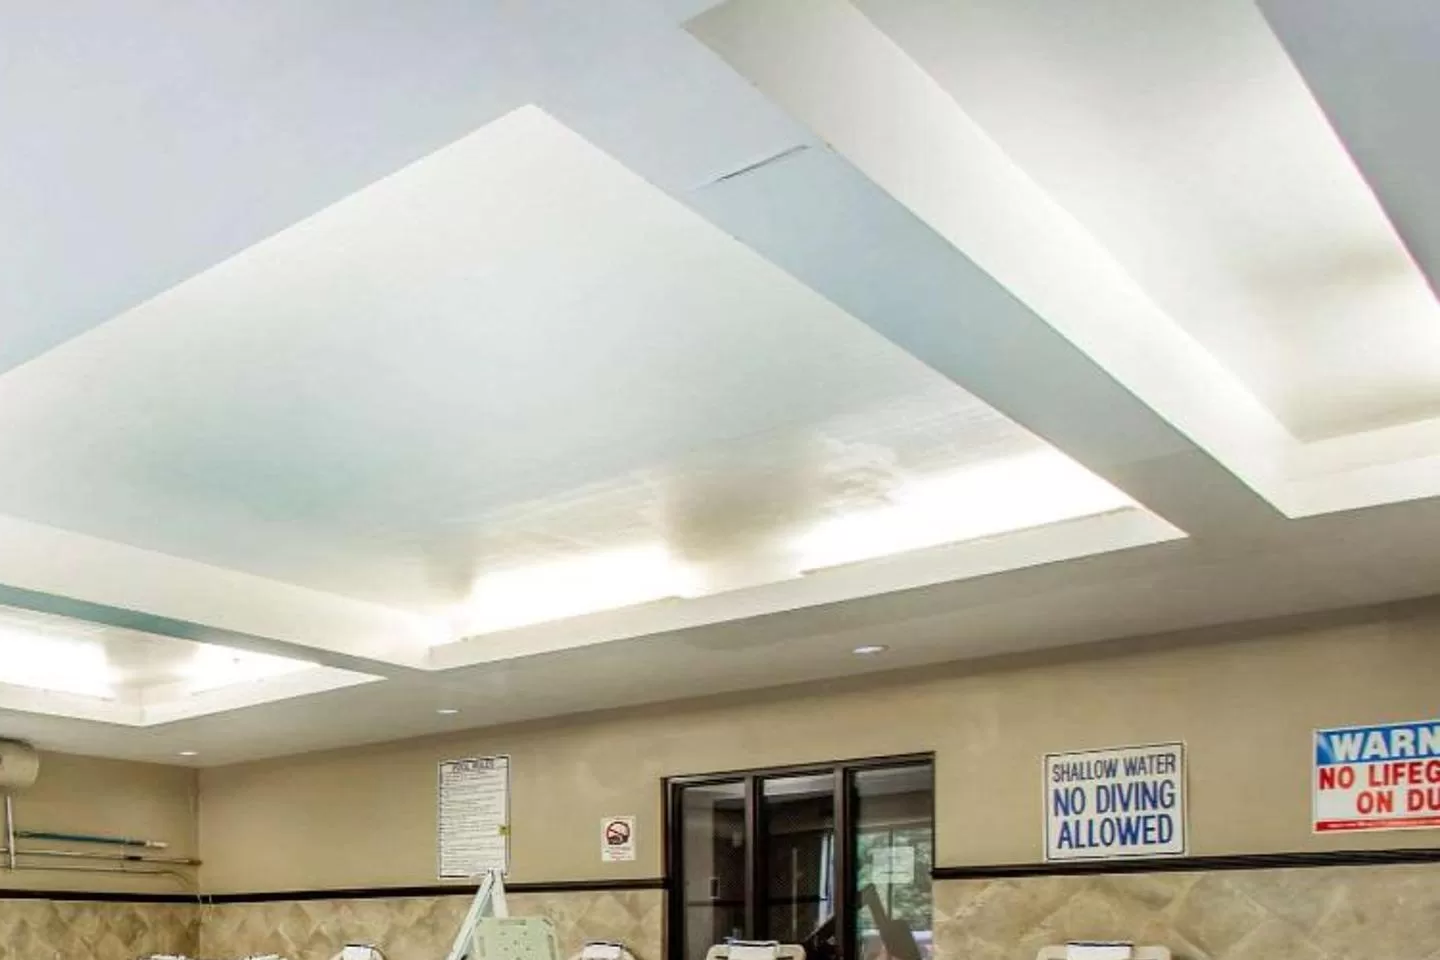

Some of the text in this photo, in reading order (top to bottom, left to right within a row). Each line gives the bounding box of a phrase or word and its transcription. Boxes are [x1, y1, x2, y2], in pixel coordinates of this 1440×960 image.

[1329, 726, 1440, 761] WARN
[1052, 752, 1176, 783] SHALLOW WATER
[1319, 760, 1440, 790] NO LIFEG
[1054, 779, 1176, 816] NO DIVING
[1356, 788, 1440, 814] ON DU
[1057, 814, 1174, 849] ALLOWED
